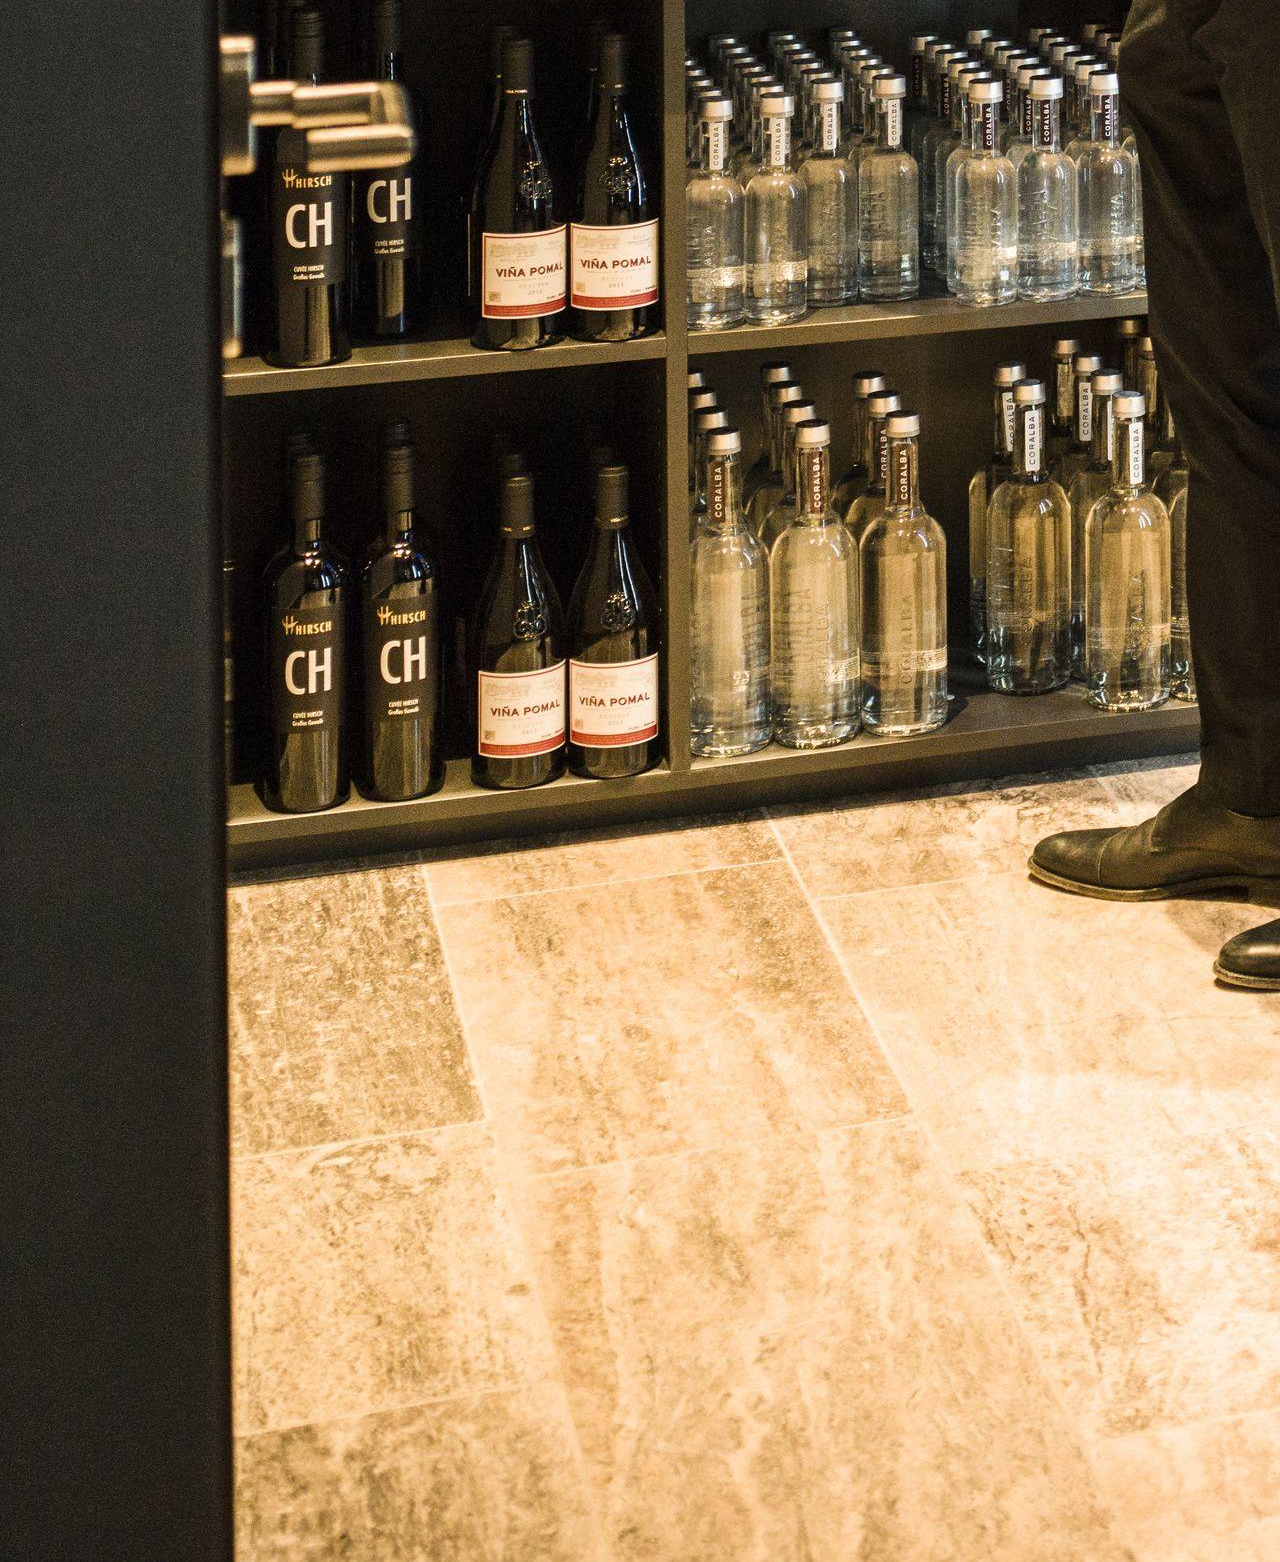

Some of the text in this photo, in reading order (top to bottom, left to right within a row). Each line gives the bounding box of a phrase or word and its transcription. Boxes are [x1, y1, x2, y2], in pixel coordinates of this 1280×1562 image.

[713, 126, 721, 166] CORALBA
[296, 175, 332, 188] HIRSCH
[367, 178, 412, 224] CH
[285, 201, 333, 249] CH
[495, 261, 564, 278] VIÑA POMAL
[580, 256, 652, 269] VIÑA POMAL
[714, 466, 722, 518] CORALBA
[814, 456, 822, 509] CORALBA
[900, 449, 908, 500] CORALBA
[295, 621, 332, 635] HIRSCH
[390, 610, 426, 626] HIRSCH
[284, 647, 332, 696] CH
[380, 636, 427, 685] CH
[490, 699, 561, 718] VIÑA POMAL
[579, 693, 650, 707] VIÑA POMAL
